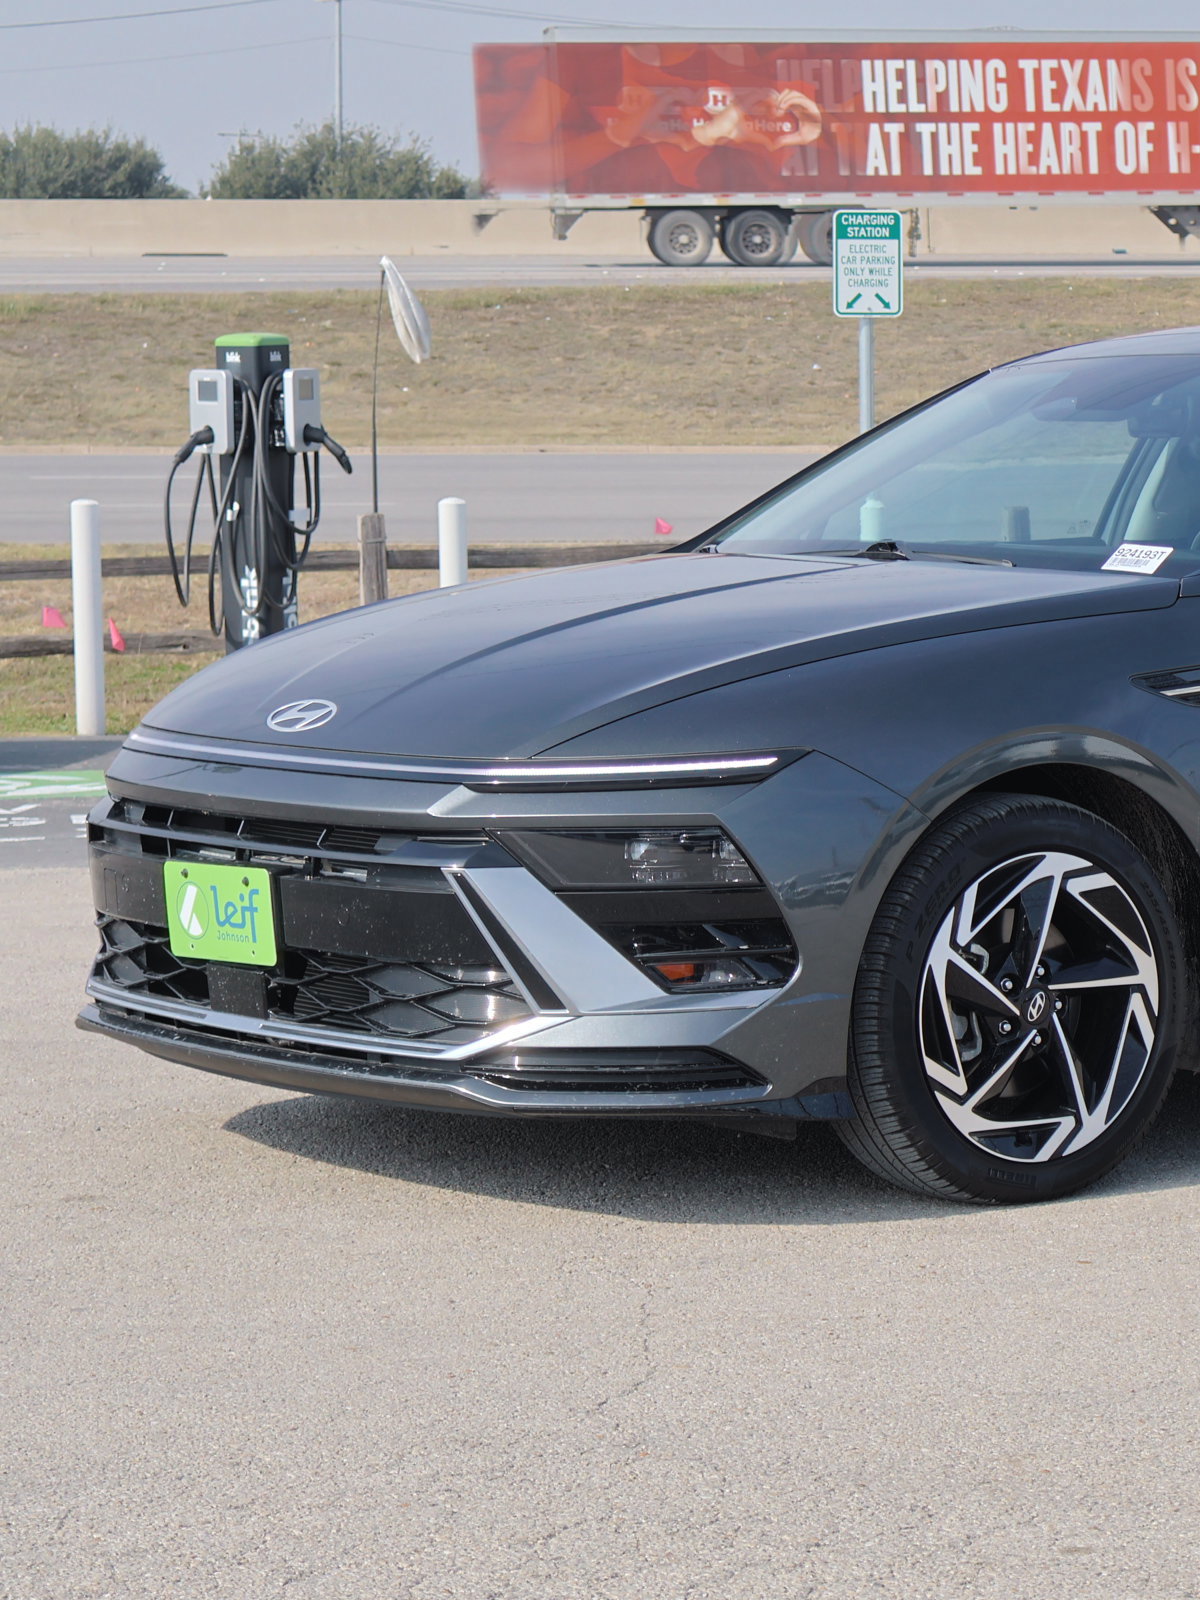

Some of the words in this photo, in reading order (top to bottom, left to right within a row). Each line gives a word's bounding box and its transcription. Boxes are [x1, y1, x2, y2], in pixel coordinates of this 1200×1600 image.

[861, 59, 1008, 113] HELPING
[1018, 58, 1154, 112] TEXANS
[1164, 58, 1199, 112] IS
[866, 122, 905, 176] AT
[915, 122, 983, 176] THE
[993, 121, 1102, 175] HEART
[1114, 121, 1155, 175] OF
[841, 215, 895, 225] CHARGING
[847, 227, 890, 237] STATION
[849, 244, 887, 254] ELECTRIC
[841, 256, 857, 265] CAR
[860, 256, 896, 265] PARKING
[843, 267, 865, 276] ONLY
[868, 267, 893, 276] WHILE
[848, 279, 889, 288] CHARGING
[1115, 548, 1166, 560] 924193T
[217, 930, 250, 944] Johnson
